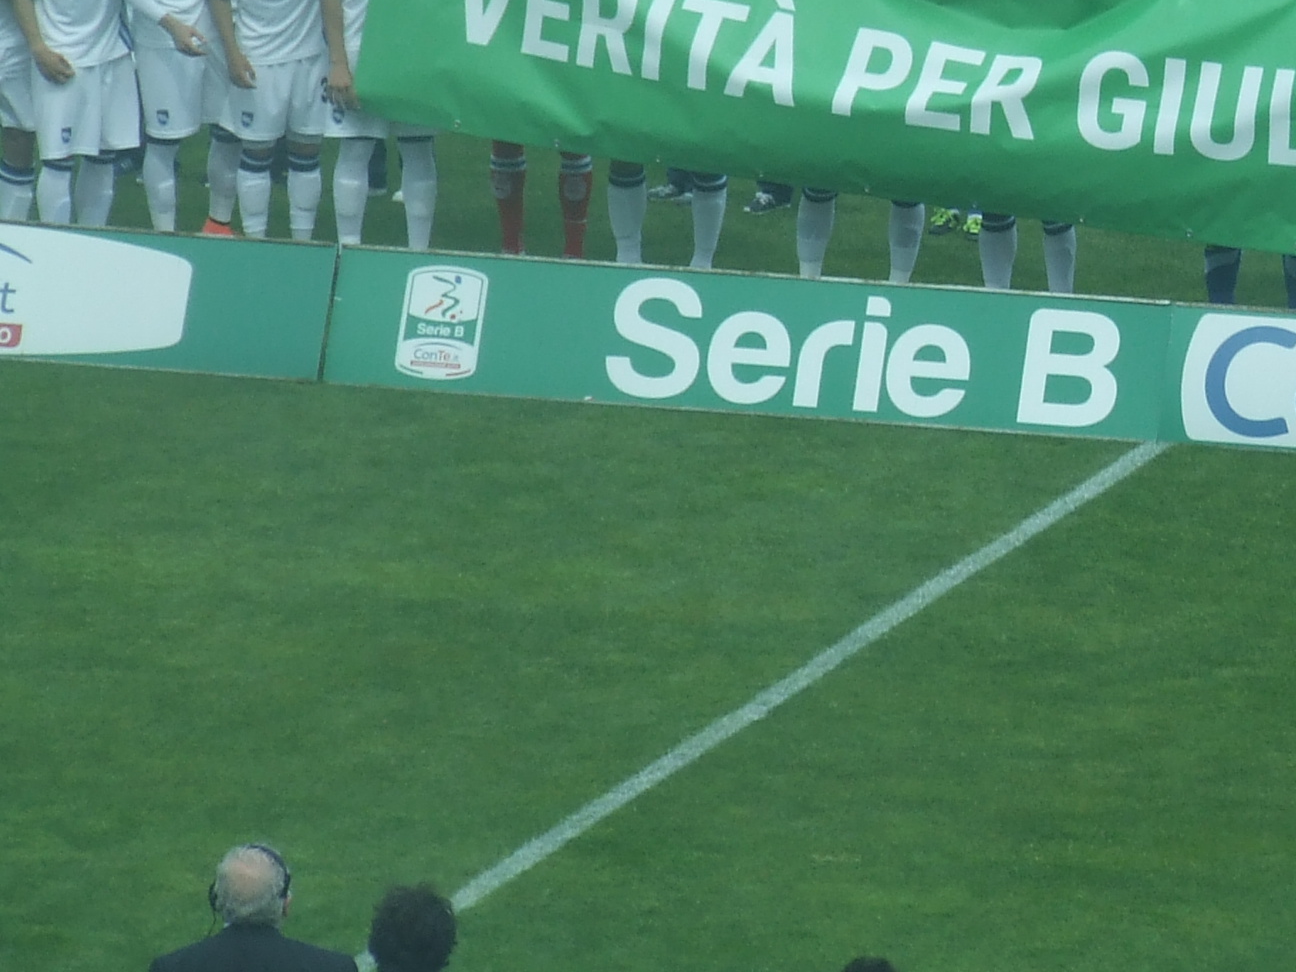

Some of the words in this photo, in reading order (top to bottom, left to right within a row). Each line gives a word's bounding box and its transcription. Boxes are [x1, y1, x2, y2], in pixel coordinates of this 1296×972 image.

[831, 26, 1042, 140] PER
[416, 322, 451, 336] Serie
[454, 325, 465, 338] B
[605, 277, 971, 418] Serie
[1016, 308, 1121, 427] B
